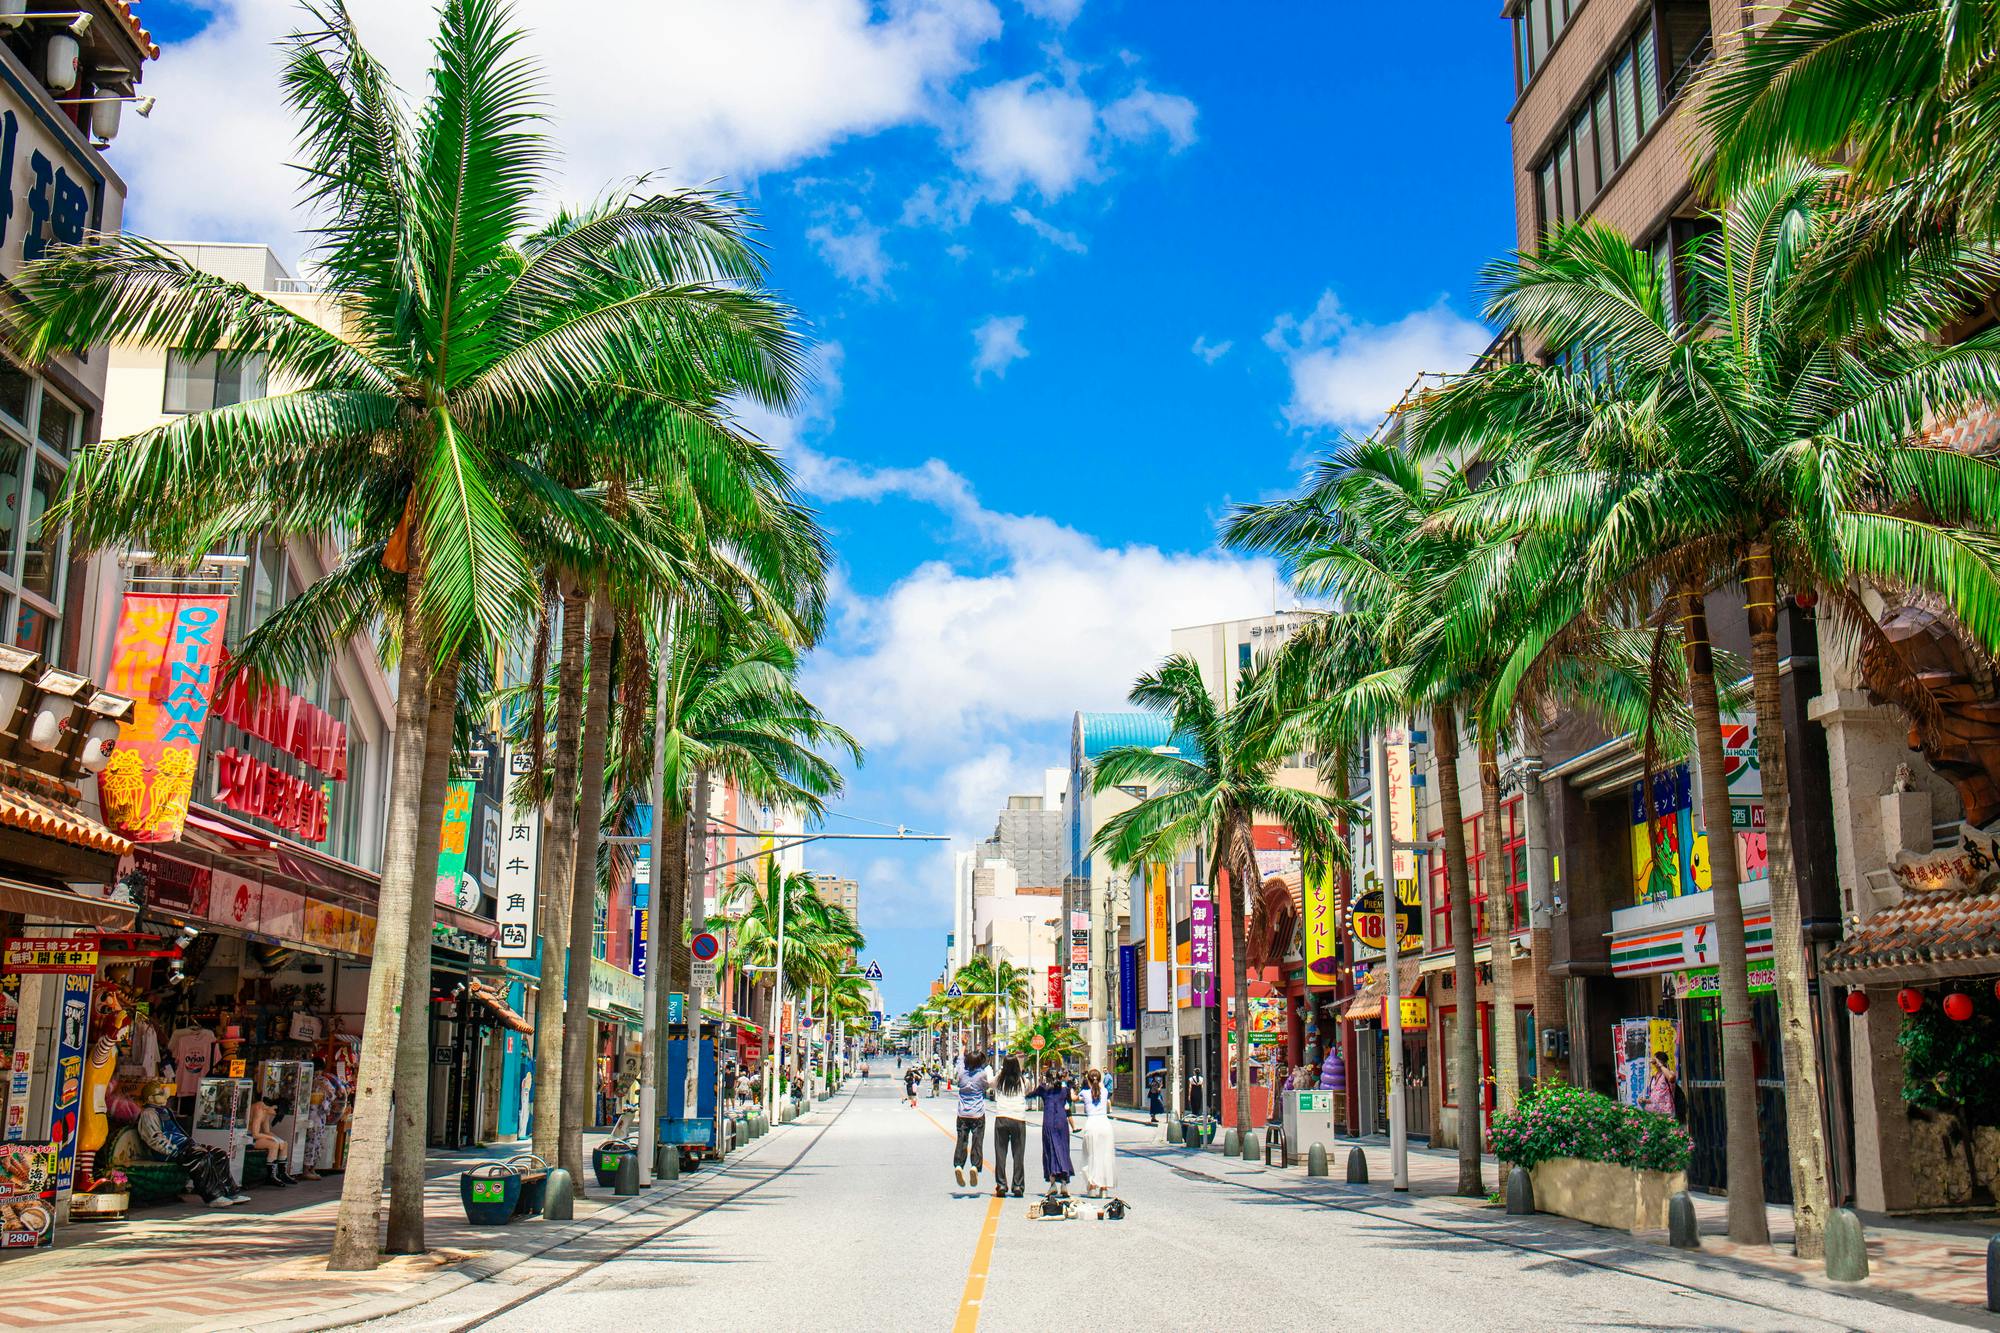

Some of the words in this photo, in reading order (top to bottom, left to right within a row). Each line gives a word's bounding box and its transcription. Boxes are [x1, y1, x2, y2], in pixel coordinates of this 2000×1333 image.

[161, 606, 219, 745] OKINAWA
[1734, 748, 1758, 757] HOLDIN
[1732, 809, 1746, 824] 酒
[1754, 808, 1765, 824] AT
[1313, 857, 1329, 955] もタルト
[1364, 901, 1384, 909] PREM
[66, 974, 91, 994] SPAM
[65, 1005, 85, 1022] SPAM
[669, 1001, 678, 1016] Ryu
[185, 1055, 205, 1064] Orion
[29, 1150, 47, 1193] 車海老
[57, 1157, 72, 1176] AM
[10, 1234, 36, 1243] 280円
